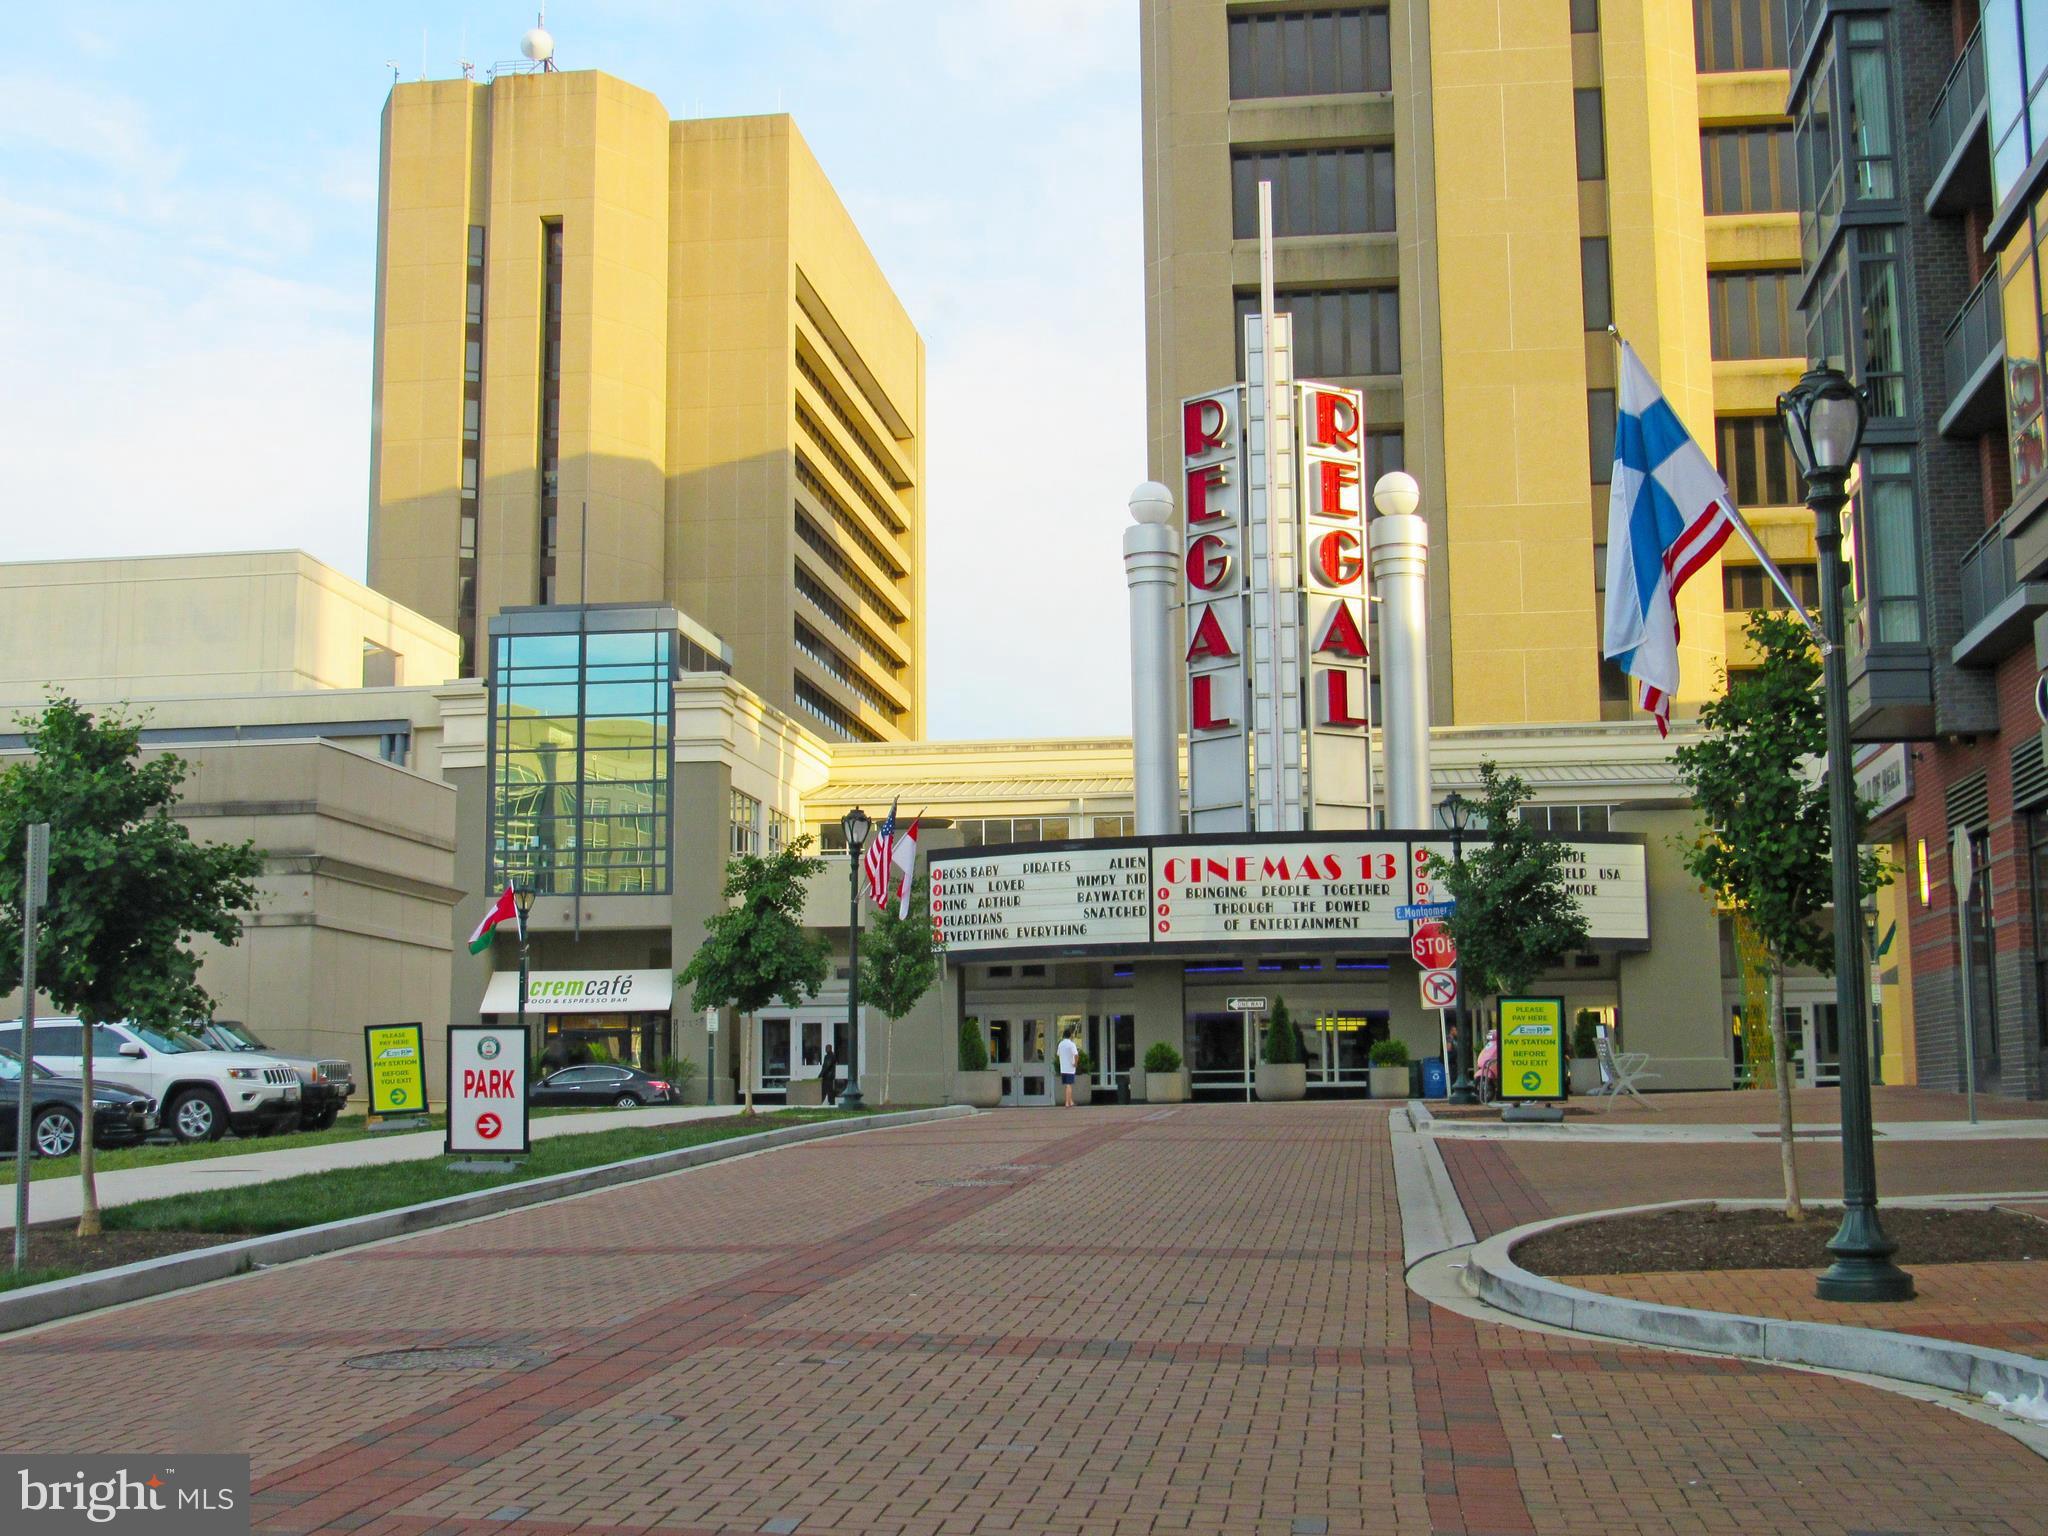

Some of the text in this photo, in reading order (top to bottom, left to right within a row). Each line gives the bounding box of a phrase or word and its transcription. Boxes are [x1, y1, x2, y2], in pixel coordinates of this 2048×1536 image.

[1184, 398, 1232, 731] REGAL
[1313, 391, 1369, 727] REGAL
[943, 867, 967, 880] BOSS
[971, 865, 999, 878] BABY
[1023, 860, 1071, 874] PIRATES
[1109, 857, 1146, 869] ALIEN
[1164, 853, 1397, 884] CINEMAS 13
[1599, 868, 1621, 880] USA
[943, 883, 974, 895] LATIN
[988, 879, 1025, 892] LOVER
[1076, 874, 1116, 887] WIMPY
[1126, 873, 1147, 885] KID
[1185, 886, 1247, 899] BRINGING
[1262, 884, 1310, 897] PEOPLE
[1323, 883, 1390, 896] TOGETHER
[1565, 884, 1597, 896] MORE
[943, 899, 967, 911] KING
[978, 895, 1021, 908] ARTHUR
[1077, 889, 1145, 903] BAYWATCH
[1214, 902, 1274, 915] THROUGH
[1293, 901, 1316, 912] THE
[1325, 900, 1370, 912] POWER
[944, 912, 1003, 927] GUARDIANS
[1083, 905, 1147, 919] SNATCHED
[1224, 919, 1240, 931] OF
[1250, 917, 1360, 930] ENTERTAINMENT
[943, 928, 1009, 942] EVERYTHING
[1017, 923, 1087, 938] EVERYTHING
[464, 1069, 515, 1098] PARK
